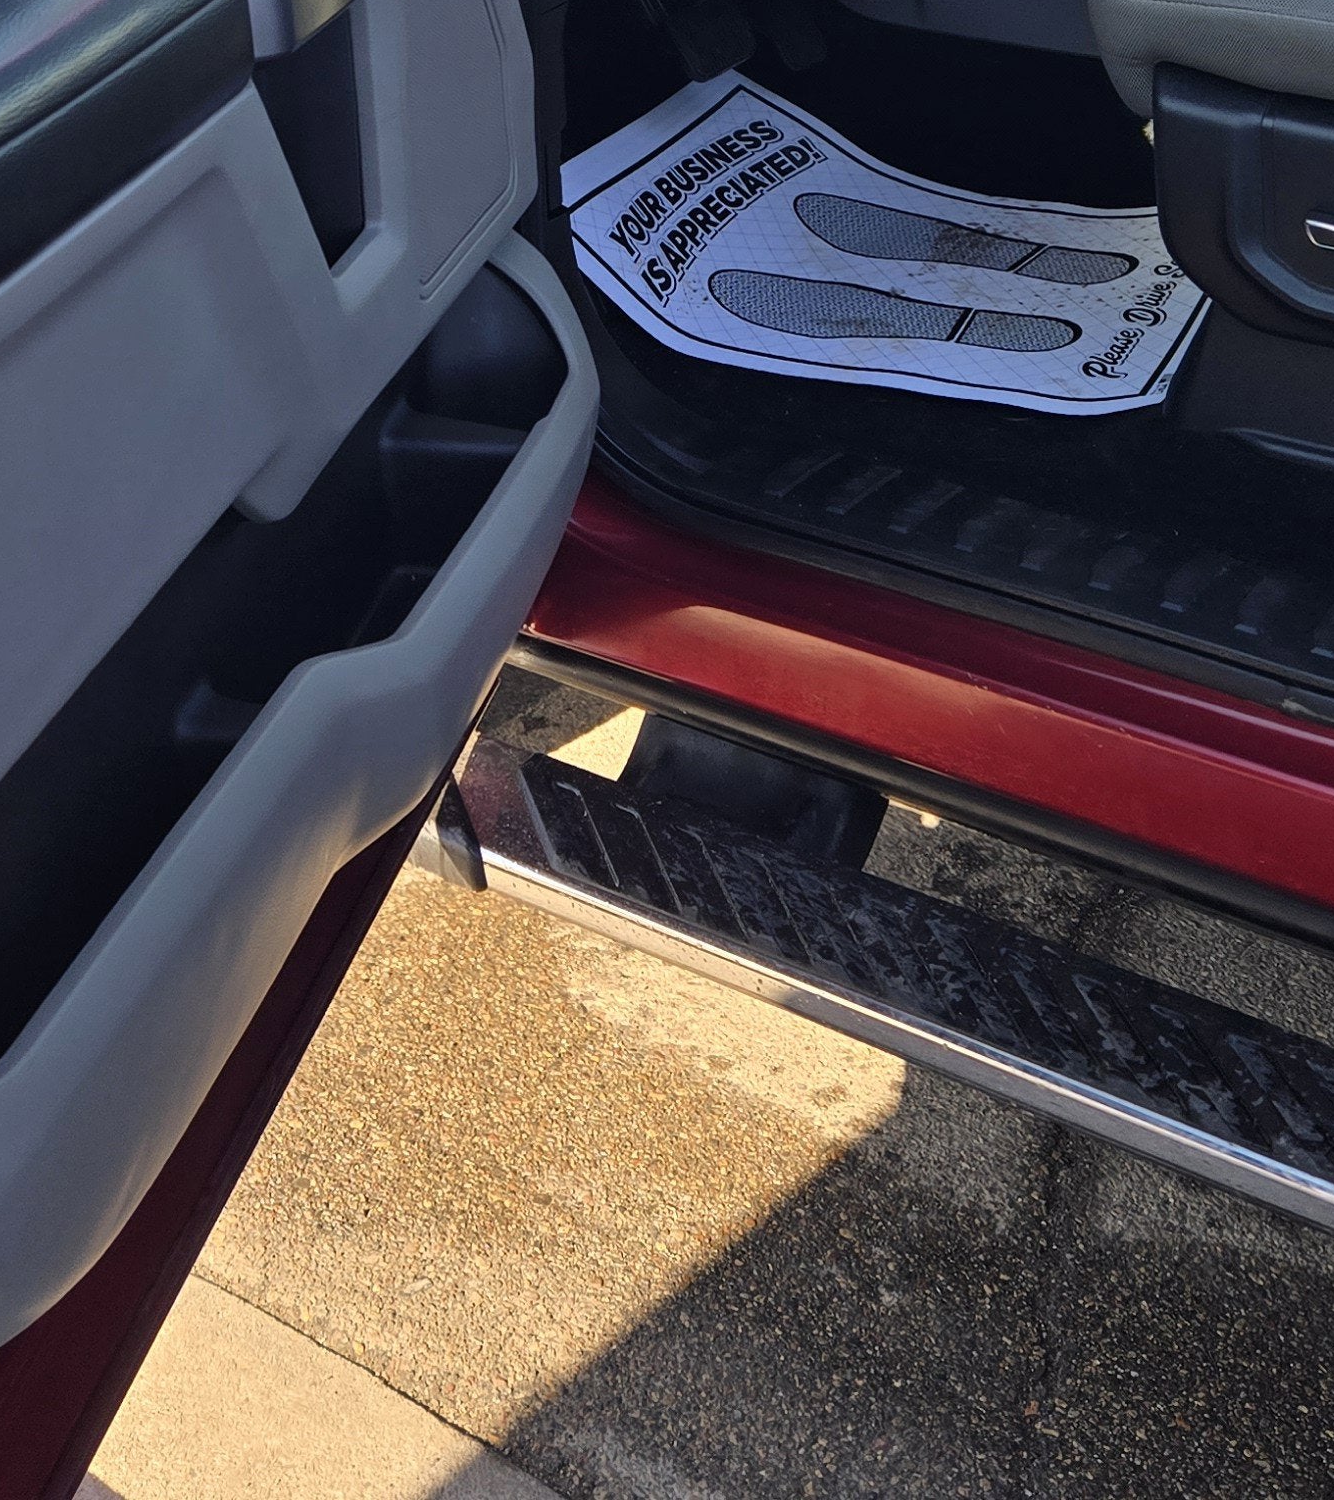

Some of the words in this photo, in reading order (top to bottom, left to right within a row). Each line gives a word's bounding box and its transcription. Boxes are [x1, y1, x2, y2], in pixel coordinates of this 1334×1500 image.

[608, 190, 670, 260] YOUR
[653, 119, 781, 209] BUSINESS
[640, 257, 674, 304] IS
[659, 136, 824, 277] APPRECIATED!
[1081, 328, 1143, 378] Please
[1123, 280, 1176, 327] Drive
